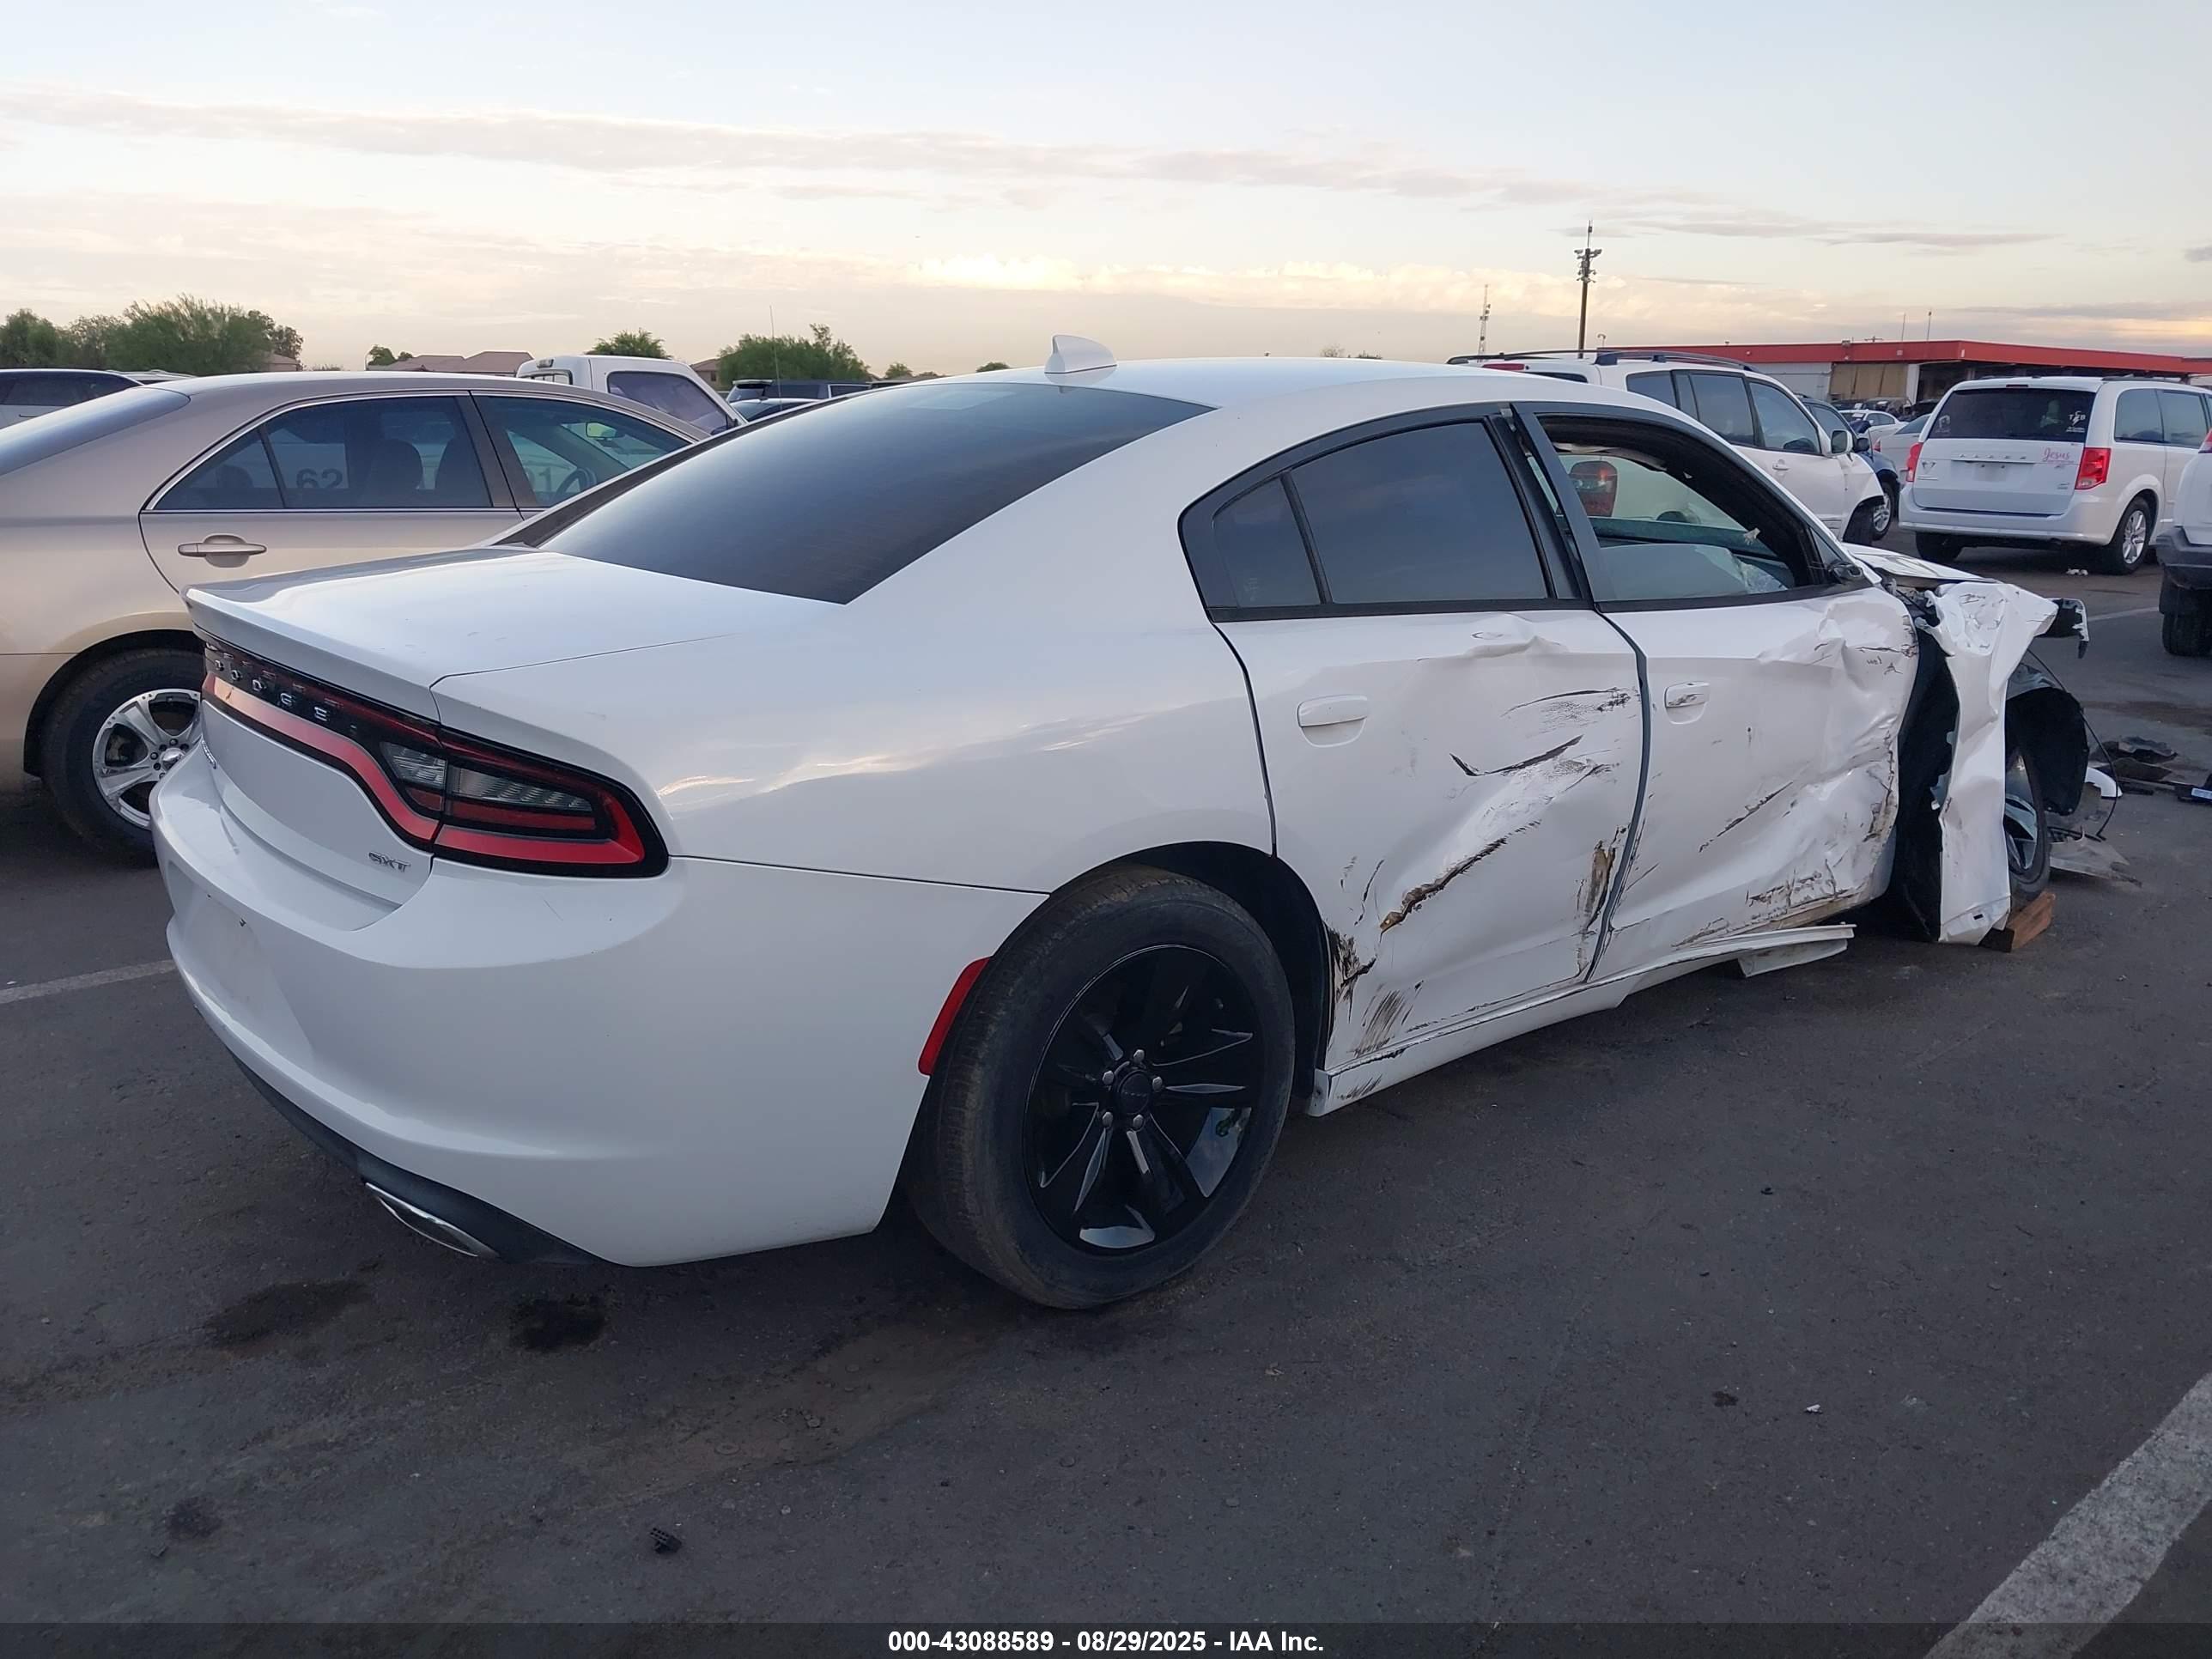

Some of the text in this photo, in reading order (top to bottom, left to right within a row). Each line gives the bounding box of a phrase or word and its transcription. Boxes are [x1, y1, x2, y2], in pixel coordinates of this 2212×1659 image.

[2042, 447, 2070, 462] Jesus
[214, 659, 329, 721] DODGE
[368, 852, 411, 872] SXT
